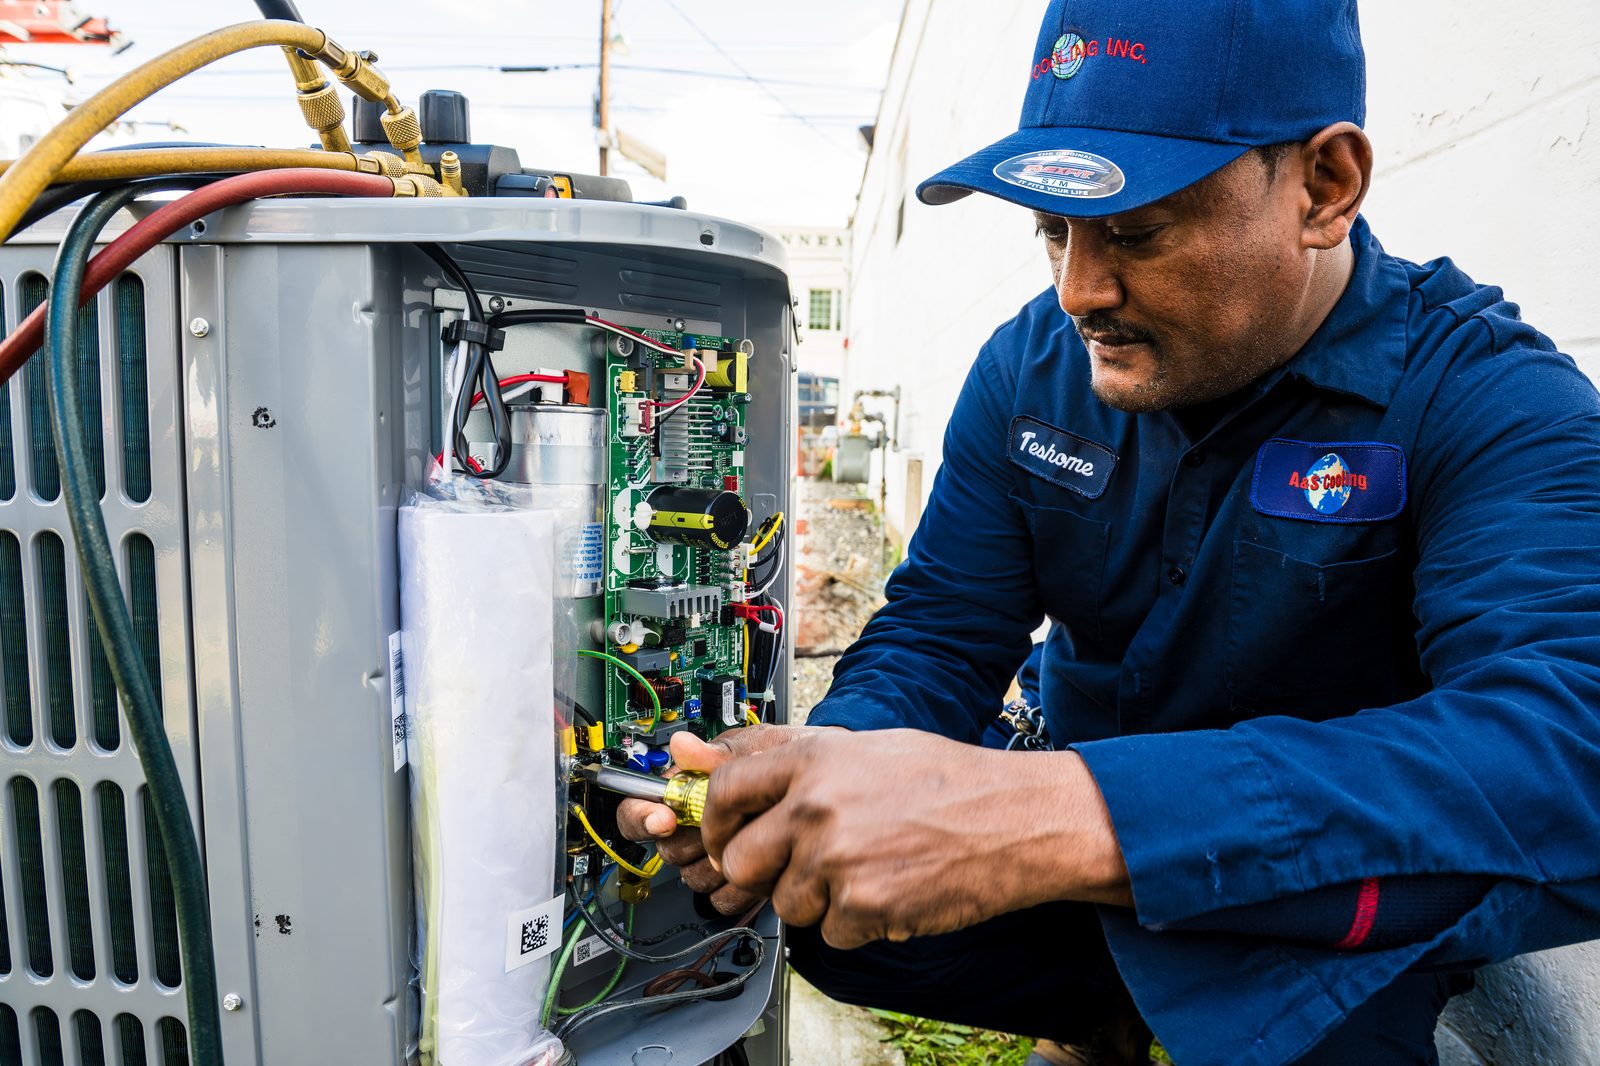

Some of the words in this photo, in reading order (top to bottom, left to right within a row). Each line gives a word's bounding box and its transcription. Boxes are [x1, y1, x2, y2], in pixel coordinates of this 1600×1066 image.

[1033, 40, 1098, 79] COOLING
[1055, 151, 1093, 161] ORIGINAL
[1027, 181, 1045, 190] FITS
[1046, 186, 1069, 194] YOUR
[1019, 431, 1094, 477] Teshome
[1288, 471, 1320, 491] A&S
[1323, 470, 1368, 491] Cooling
